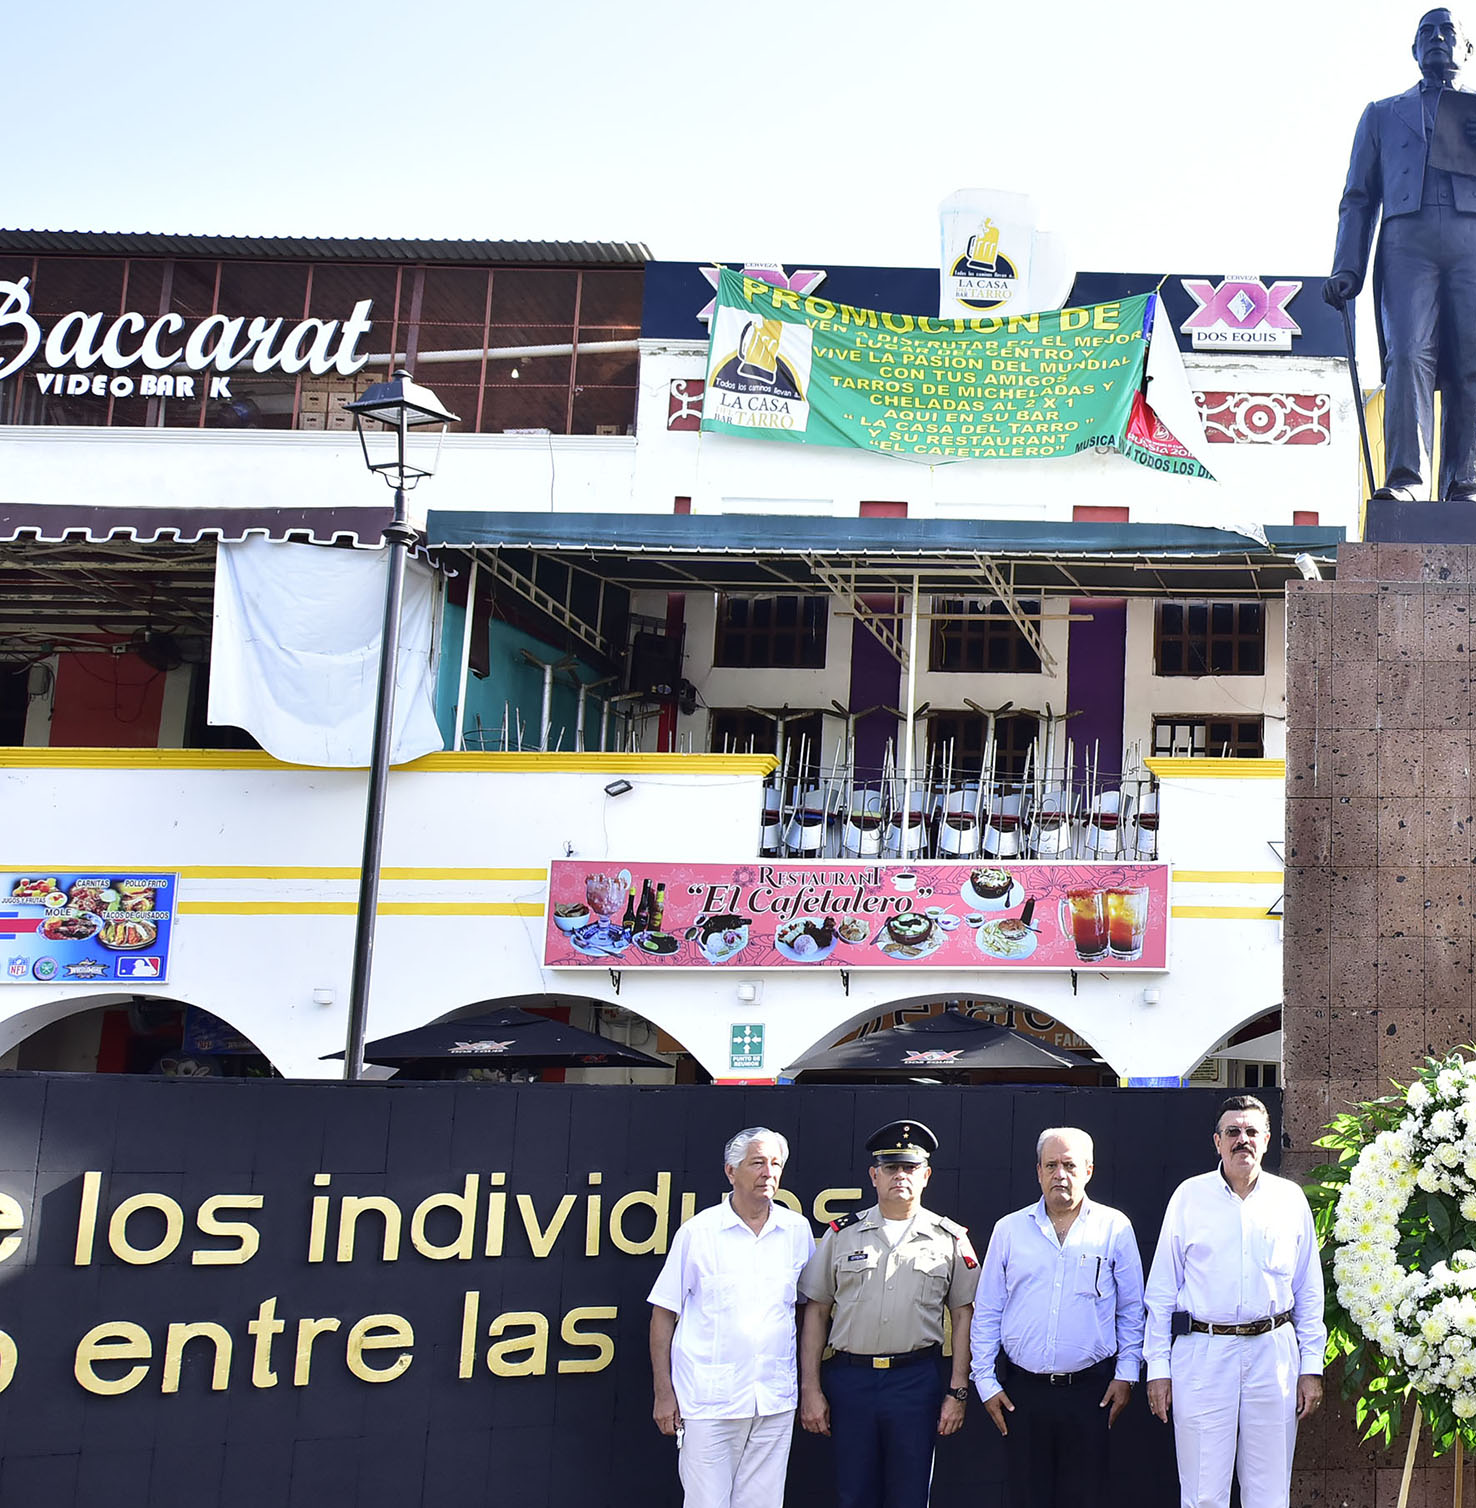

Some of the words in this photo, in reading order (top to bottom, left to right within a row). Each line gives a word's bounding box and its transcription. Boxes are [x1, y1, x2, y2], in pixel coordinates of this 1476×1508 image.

[958, 279, 974, 288] LA
[976, 279, 1009, 289] CASA
[968, 288, 1013, 299] TARRO
[743, 276, 1041, 335] PROMOCION
[1060, 302, 1122, 332] DE
[0, 276, 373, 380] Baccarat
[804, 318, 849, 333] VEN
[877, 333, 1000, 350] DISFRUTAR
[1042, 335, 1068, 347] EL
[1074, 330, 1143, 347] MEJOR
[1196, 331, 1228, 342] DOS
[1232, 332, 1278, 343] EQUIS
[855, 337, 930, 354] LUGAR
[986, 346, 1075, 361] CENTRO
[1081, 349, 1095, 359] Y
[812, 345, 862, 361] VIVE
[869, 352, 896, 364] LA
[903, 354, 984, 370] PASION
[990, 360, 1033, 373] DEL
[1039, 356, 1132, 374] MUNDIAL
[36, 373, 135, 397] VIDEO
[140, 374, 196, 398] BAR
[209, 376, 232, 399] K
[715, 376, 736, 390] Todos
[737, 383, 747, 392] los
[748, 384, 772, 393] caminos
[879, 366, 926, 380] CON
[932, 369, 977, 384] TUS
[983, 374, 1069, 387] AMIGOS
[829, 376, 915, 394] TARROS
[922, 383, 950, 396] DE
[957, 384, 1096, 399] MICHELADAS
[1101, 380, 1115, 391] Y
[720, 392, 743, 410] LA
[747, 396, 791, 415] CASA
[869, 395, 985, 411] CHELADAS
[991, 400, 1018, 411] AL
[1024, 399, 1037, 408] 2
[1065, 398, 1075, 408] 1
[735, 410, 795, 429] TARRO
[860, 416, 888, 428] LA
[895, 421, 954, 434] CASA
[961, 423, 1001, 434] DEL
[1007, 420, 1080, 434] TARRO
[884, 409, 939, 422] AQUI
[945, 412, 974, 423] EN
[982, 412, 1009, 422] SU
[1016, 410, 1060, 421] BAR
[868, 428, 882, 438] Y
[889, 432, 919, 443] SU
[926, 433, 1070, 447] RESTAURANT
[1127, 432, 1169, 455] RUSSIA
[1074, 434, 1116, 453] MUSICA
[1134, 449, 1171, 472] TODOS
[1172, 460, 1195, 476] LOS
[76, 878, 111, 888] CARNITAS
[125, 879, 147, 888] POLLO
[148, 879, 169, 889] FRITO
[758, 865, 887, 889] RESTAURANT
[45, 908, 72, 917] MOLE
[103, 911, 125, 920] TACOS
[126, 911, 135, 920] DE
[135, 911, 170, 920] GUISADOS
[10, 964, 26, 975] NFL
[75, 1171, 265, 1266] los
[74, 1296, 415, 1396] entre
[458, 1290, 618, 1380] las
